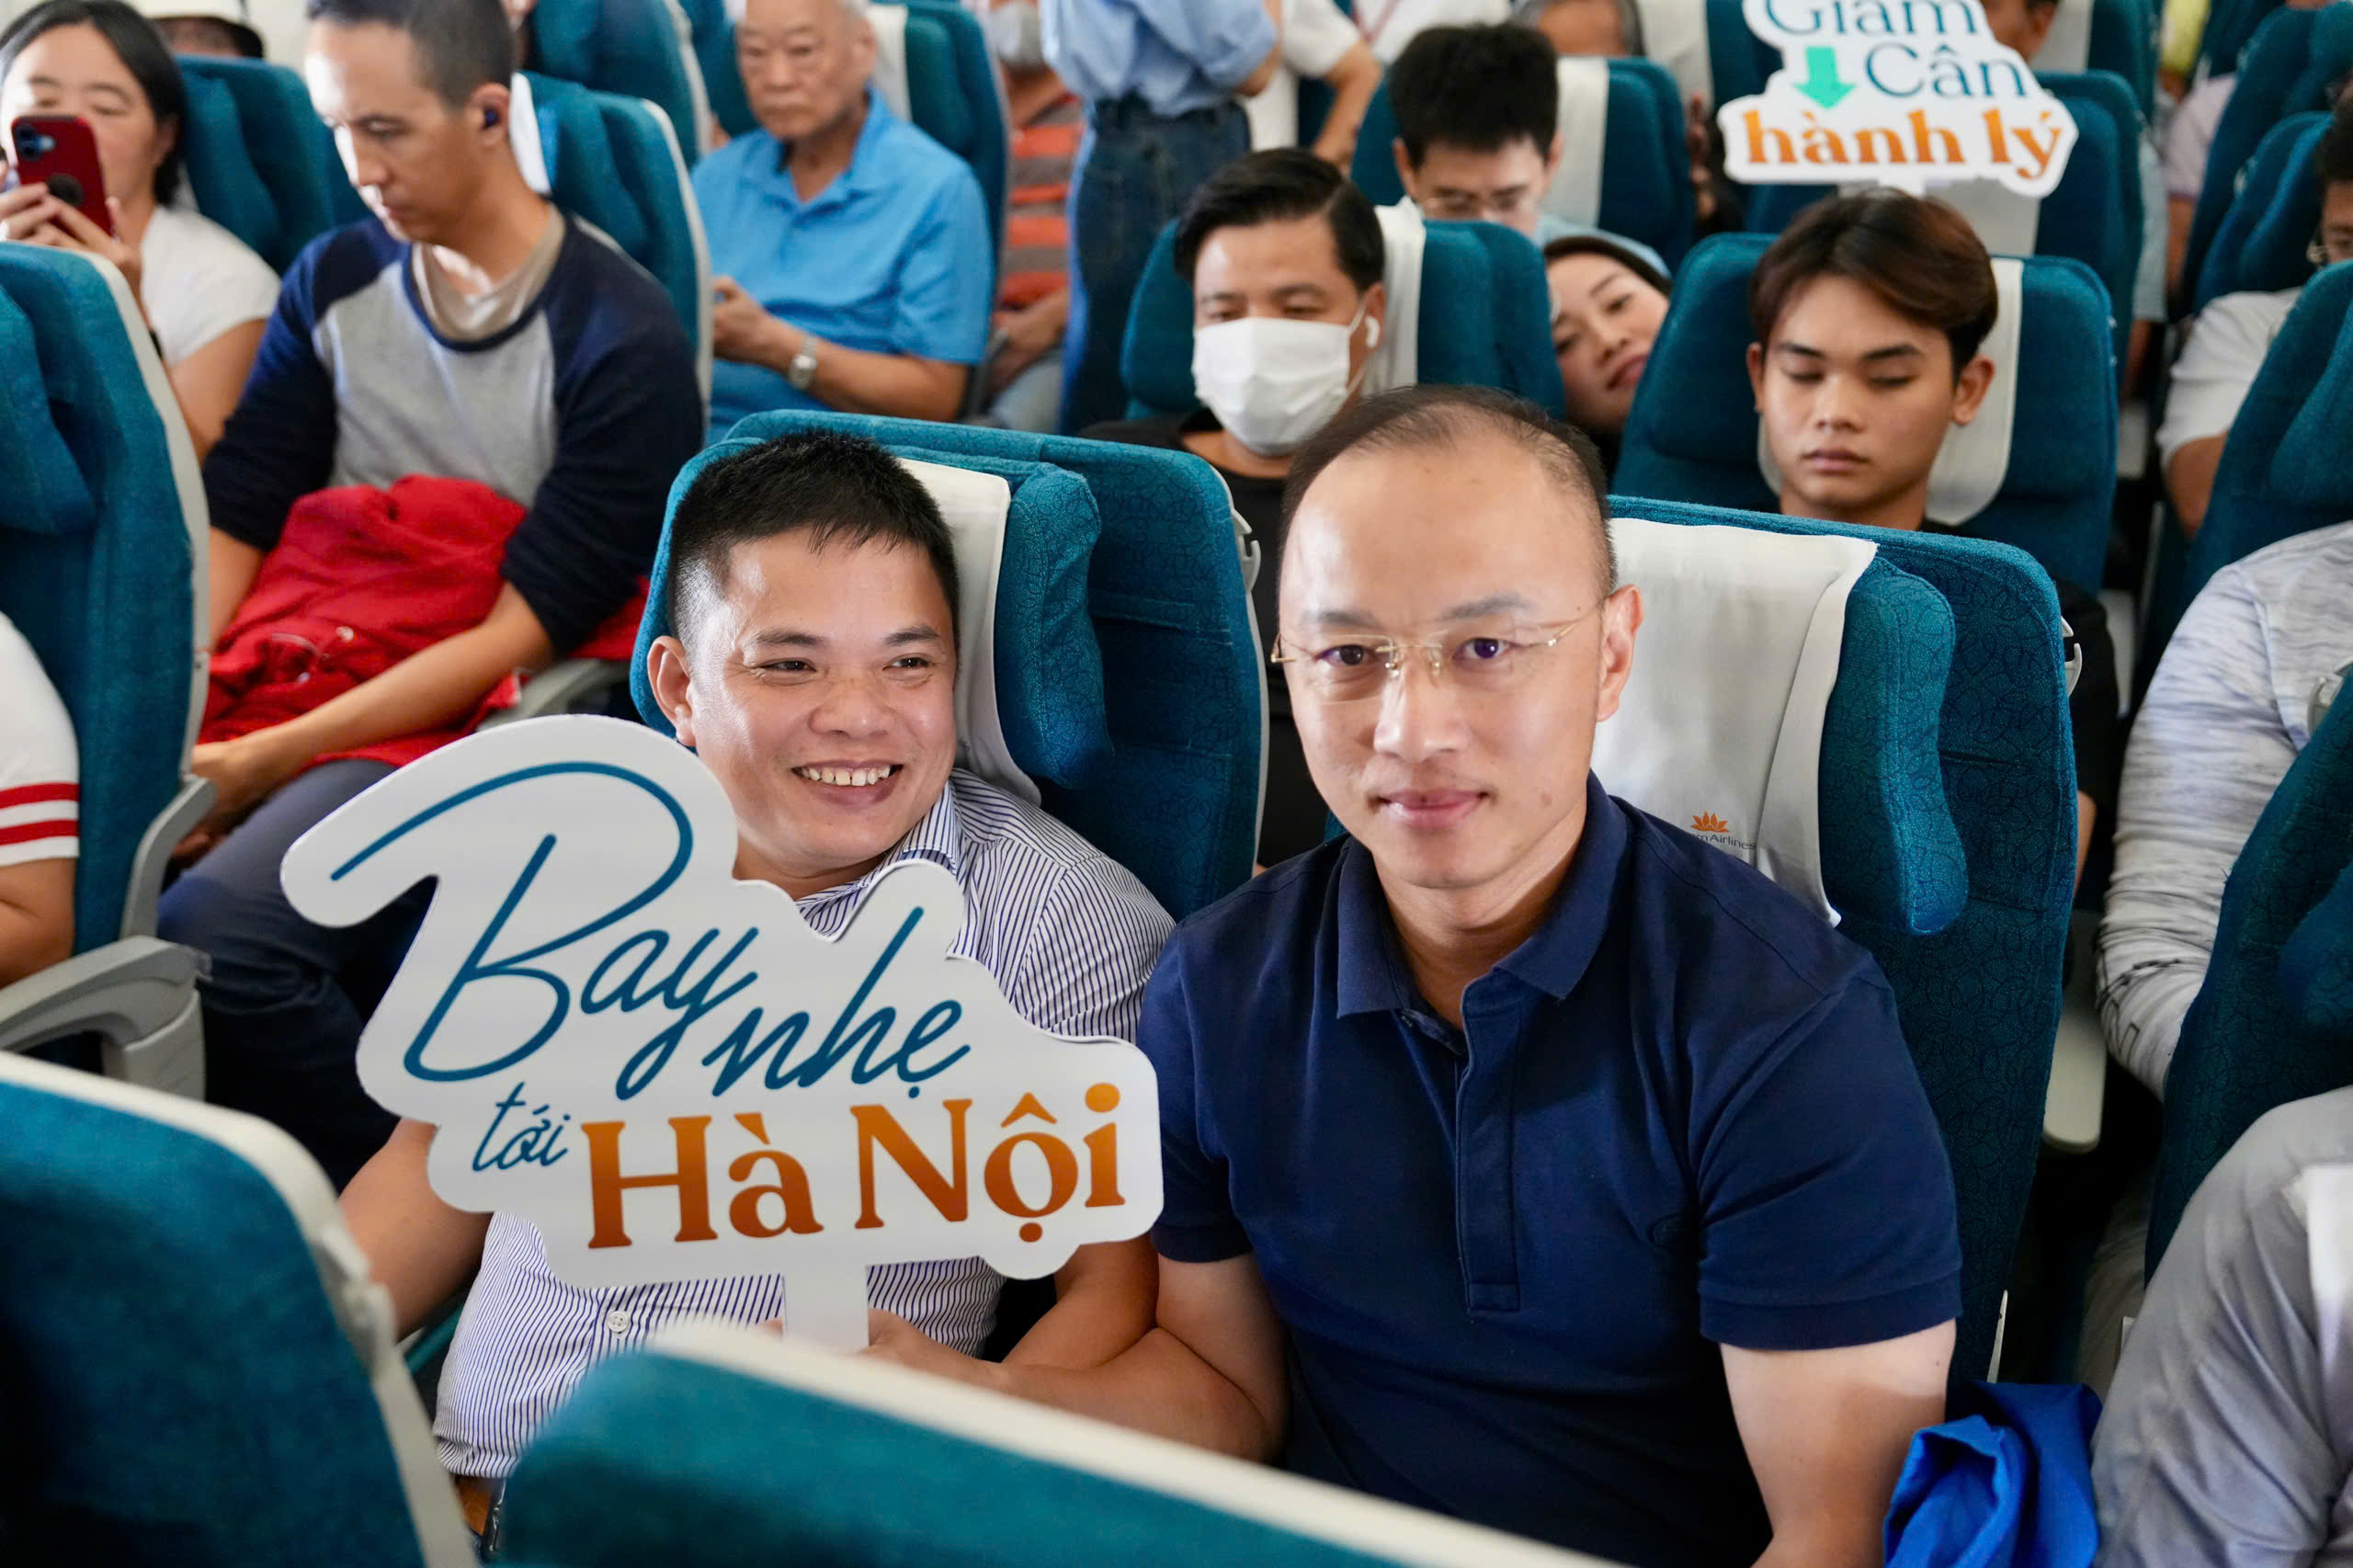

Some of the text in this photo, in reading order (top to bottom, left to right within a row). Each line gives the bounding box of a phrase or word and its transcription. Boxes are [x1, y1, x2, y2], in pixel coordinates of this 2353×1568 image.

[1865, 42, 2028, 98] Cân
[1740, 107, 2062, 180] hành lý
[1710, 834, 1756, 850] Airlines
[332, 761, 972, 1100] Bay nhẹ
[472, 1082, 1127, 1250] tới Hà Nội
